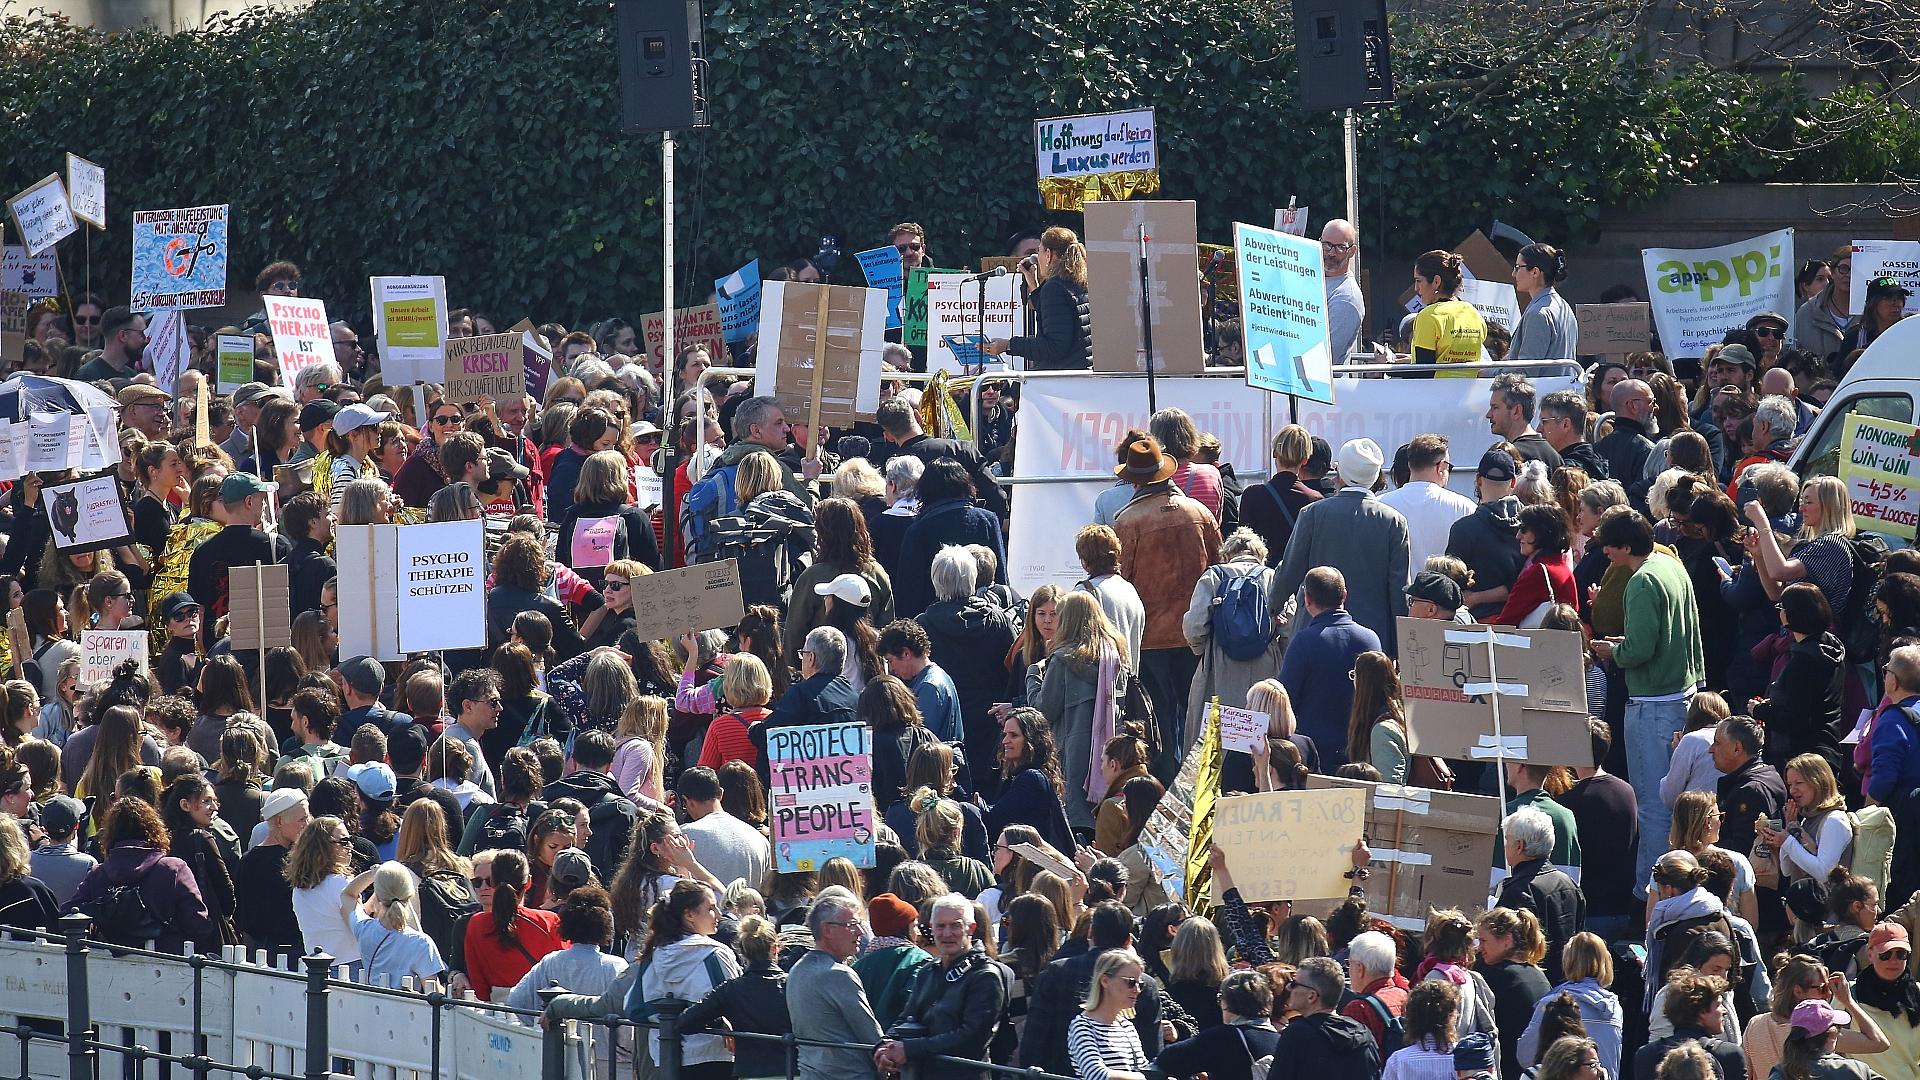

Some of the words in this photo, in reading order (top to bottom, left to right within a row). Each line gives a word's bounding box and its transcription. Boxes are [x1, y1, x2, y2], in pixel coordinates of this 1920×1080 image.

[1040, 123, 1102, 151] Hoffnung
[1105, 120, 1124, 142] darf
[1125, 121, 1152, 141] kein
[1052, 152, 1110, 173] Luxus
[1111, 145, 1150, 166] werden
[154, 223, 168, 234] MIT
[1244, 237, 1299, 261] Abwertung
[40, 262, 54, 271] Wir
[1246, 252, 1262, 264] der
[1264, 256, 1316, 278] Leistungen
[1656, 244, 1780, 302] app:
[1874, 269, 1910, 278] KÜRZEN
[1670, 271, 1708, 286] app:
[272, 303, 320, 320] PSYCHO
[720, 304, 738, 314] Wir
[739, 290, 760, 308] lassen
[1249, 288, 1304, 312] Abwertung
[1306, 301, 1320, 314] der
[721, 314, 738, 323] uns
[740, 302, 758, 318] nicht
[984, 314, 1015, 323] HEUTE
[270, 320, 328, 340] THERAPIE
[298, 340, 314, 352] IST
[446, 340, 468, 361] WIR
[470, 335, 519, 353] BEHANDELN
[1680, 340, 1699, 350] Gegen
[463, 352, 509, 374] KRISEN
[448, 380, 464, 398] IHR
[1856, 424, 1908, 449] HONORAR
[1857, 478, 1907, 502] -4,5%
[412, 552, 469, 566] PSYCHO
[408, 566, 474, 582] THERAPIE
[410, 583, 473, 597] SCHÜTZEN
[86, 634, 127, 655] Sparen
[88, 654, 116, 666] aber
[1405, 686, 1468, 702] BAUHAUS
[770, 724, 867, 765] PROTECT
[773, 760, 853, 794] TRANS
[777, 802, 864, 838] PEOPLE
